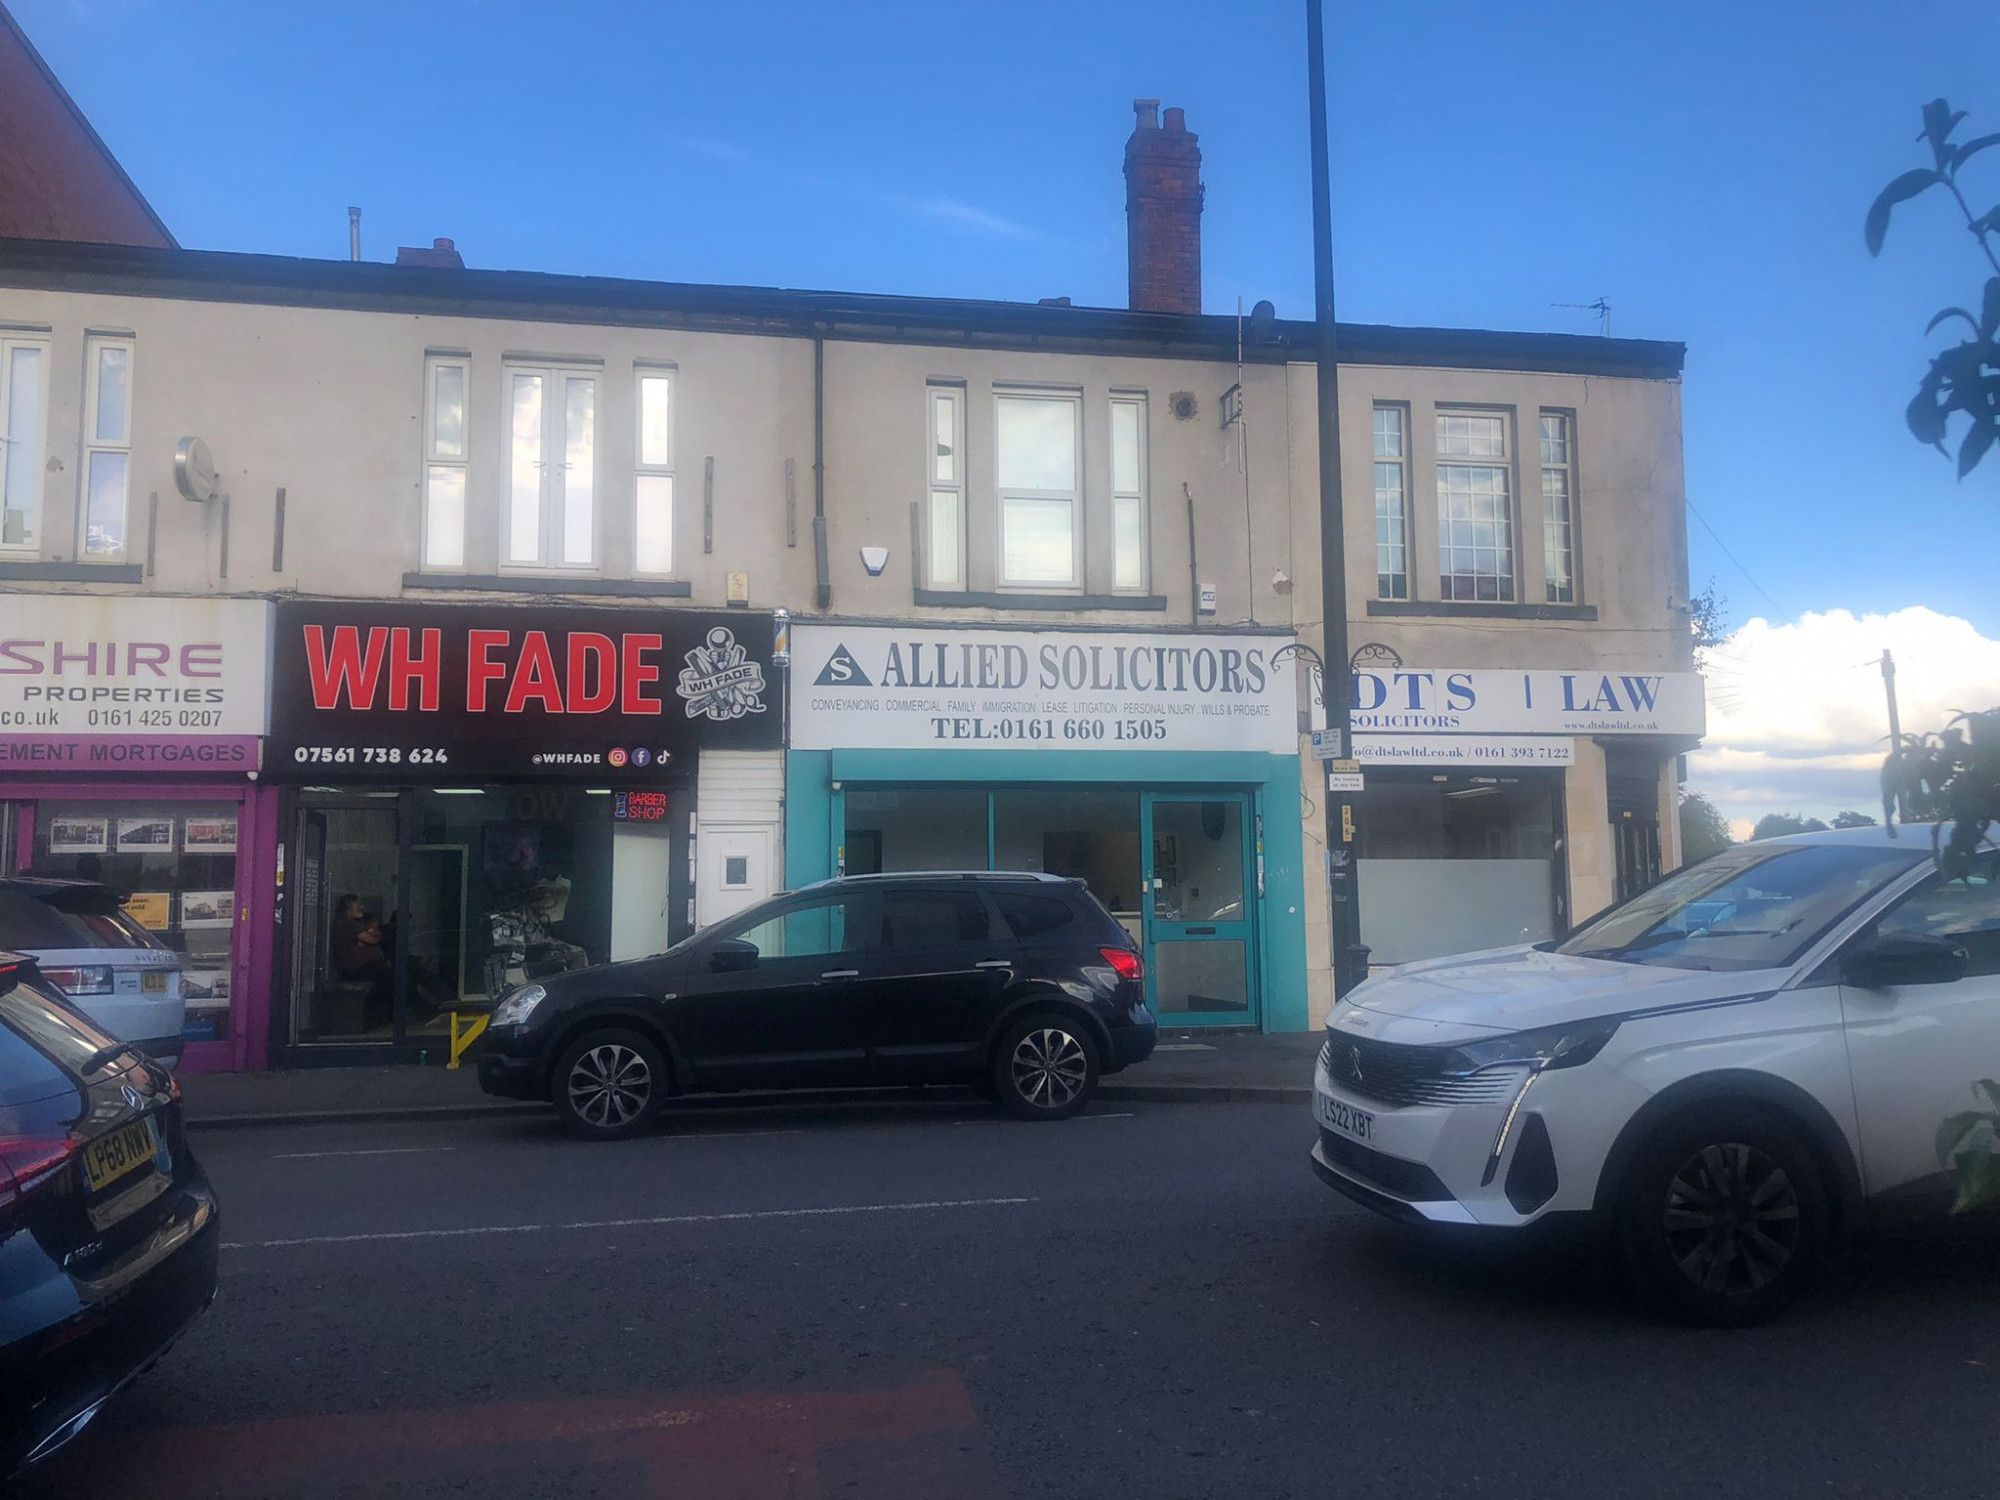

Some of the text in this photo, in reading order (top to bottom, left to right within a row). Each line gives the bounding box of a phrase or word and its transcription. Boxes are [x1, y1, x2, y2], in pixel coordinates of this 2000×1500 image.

[0, 640, 222, 678] SHIRE
[880, 642, 1266, 694] ALLIED SOLICITORS
[303, 624, 662, 715] WH FADE
[689, 667, 753, 692] WH FADE
[24, 686, 224, 703] PROPERTIES
[1350, 673, 1476, 711] DTS
[1560, 675, 1664, 712] LAW
[811, 699, 1270, 717] CONVEYANCING COMMERCIAL FAMILY IMMIGRATION LEASE LITIGATION PERSONAL INJURY WILLS & PROBATE
[88, 709, 131, 726] 0161
[139, 710, 172, 727] 425
[179, 710, 222, 727] 0207
[1564, 721, 1659, 730] www.dtslawltd.co.uk
[931, 718, 1167, 740] TEL:0161 660 1505
[90, 744, 245, 762] MORTGAGES
[294, 747, 448, 764] 07561 738 624
[532, 753, 600, 765] @WHFADE
[1475, 747, 1505, 758] 0161
[1511, 748, 1534, 759] 393
[1539, 748, 1569, 759] 7122
[628, 792, 666, 807] BARBER
[628, 806, 665, 819] SHOP
